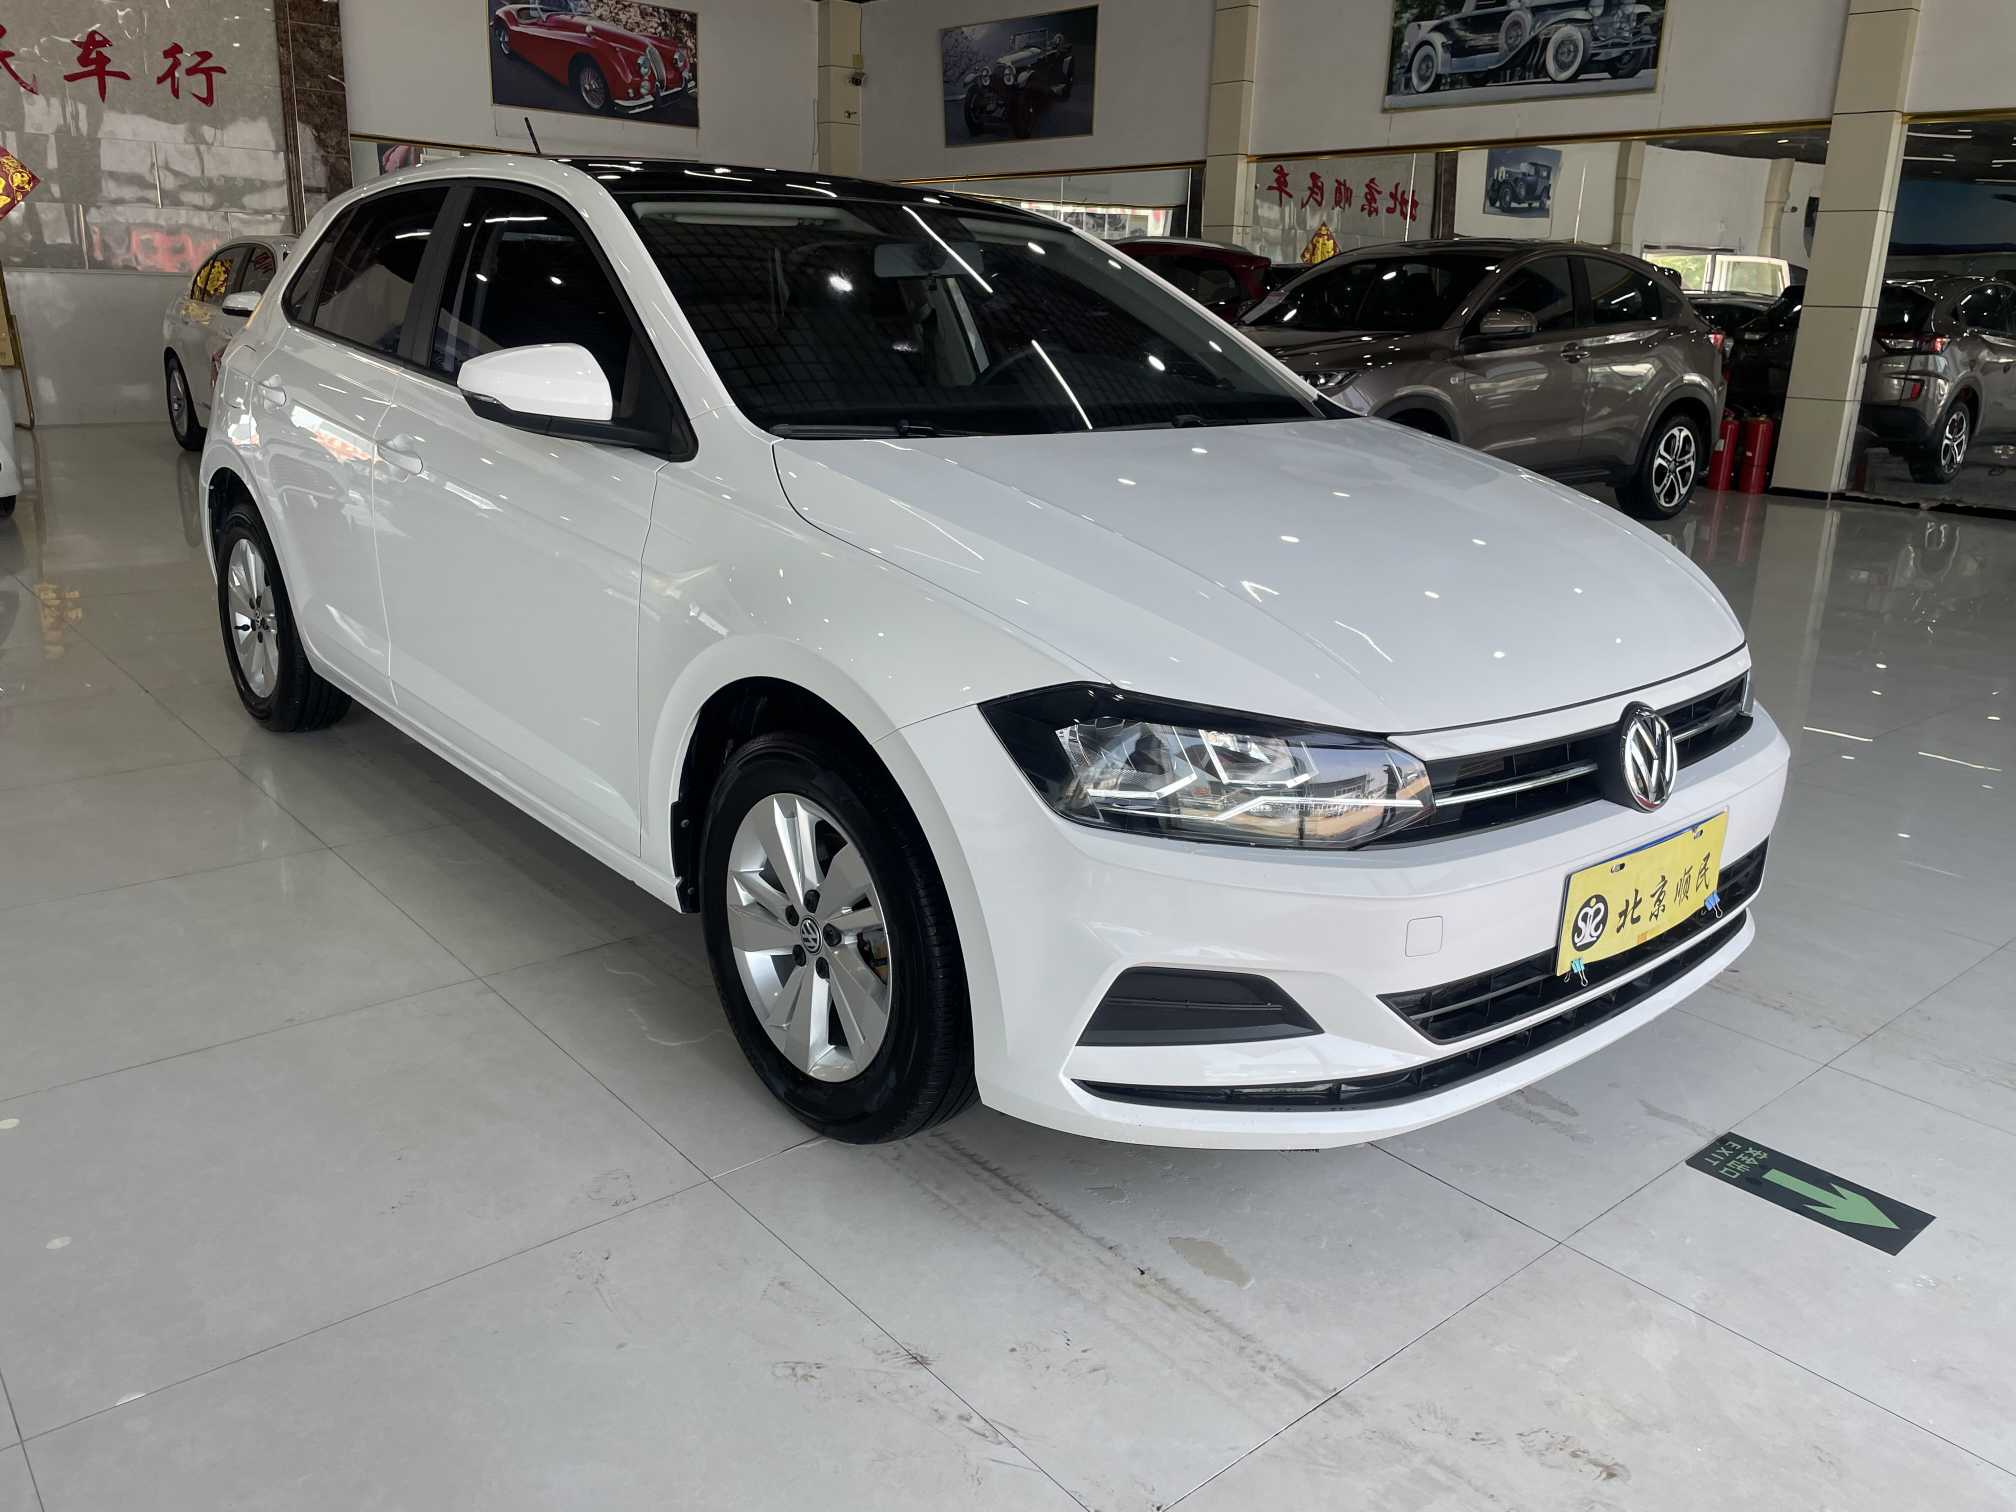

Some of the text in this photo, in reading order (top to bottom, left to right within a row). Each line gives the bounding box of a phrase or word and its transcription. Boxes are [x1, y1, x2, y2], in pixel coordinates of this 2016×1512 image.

[1616, 851, 1711, 934] 北京顺民
[1704, 1141, 1742, 1166] EXIT
[1719, 1147, 1768, 1179] 安全出口
